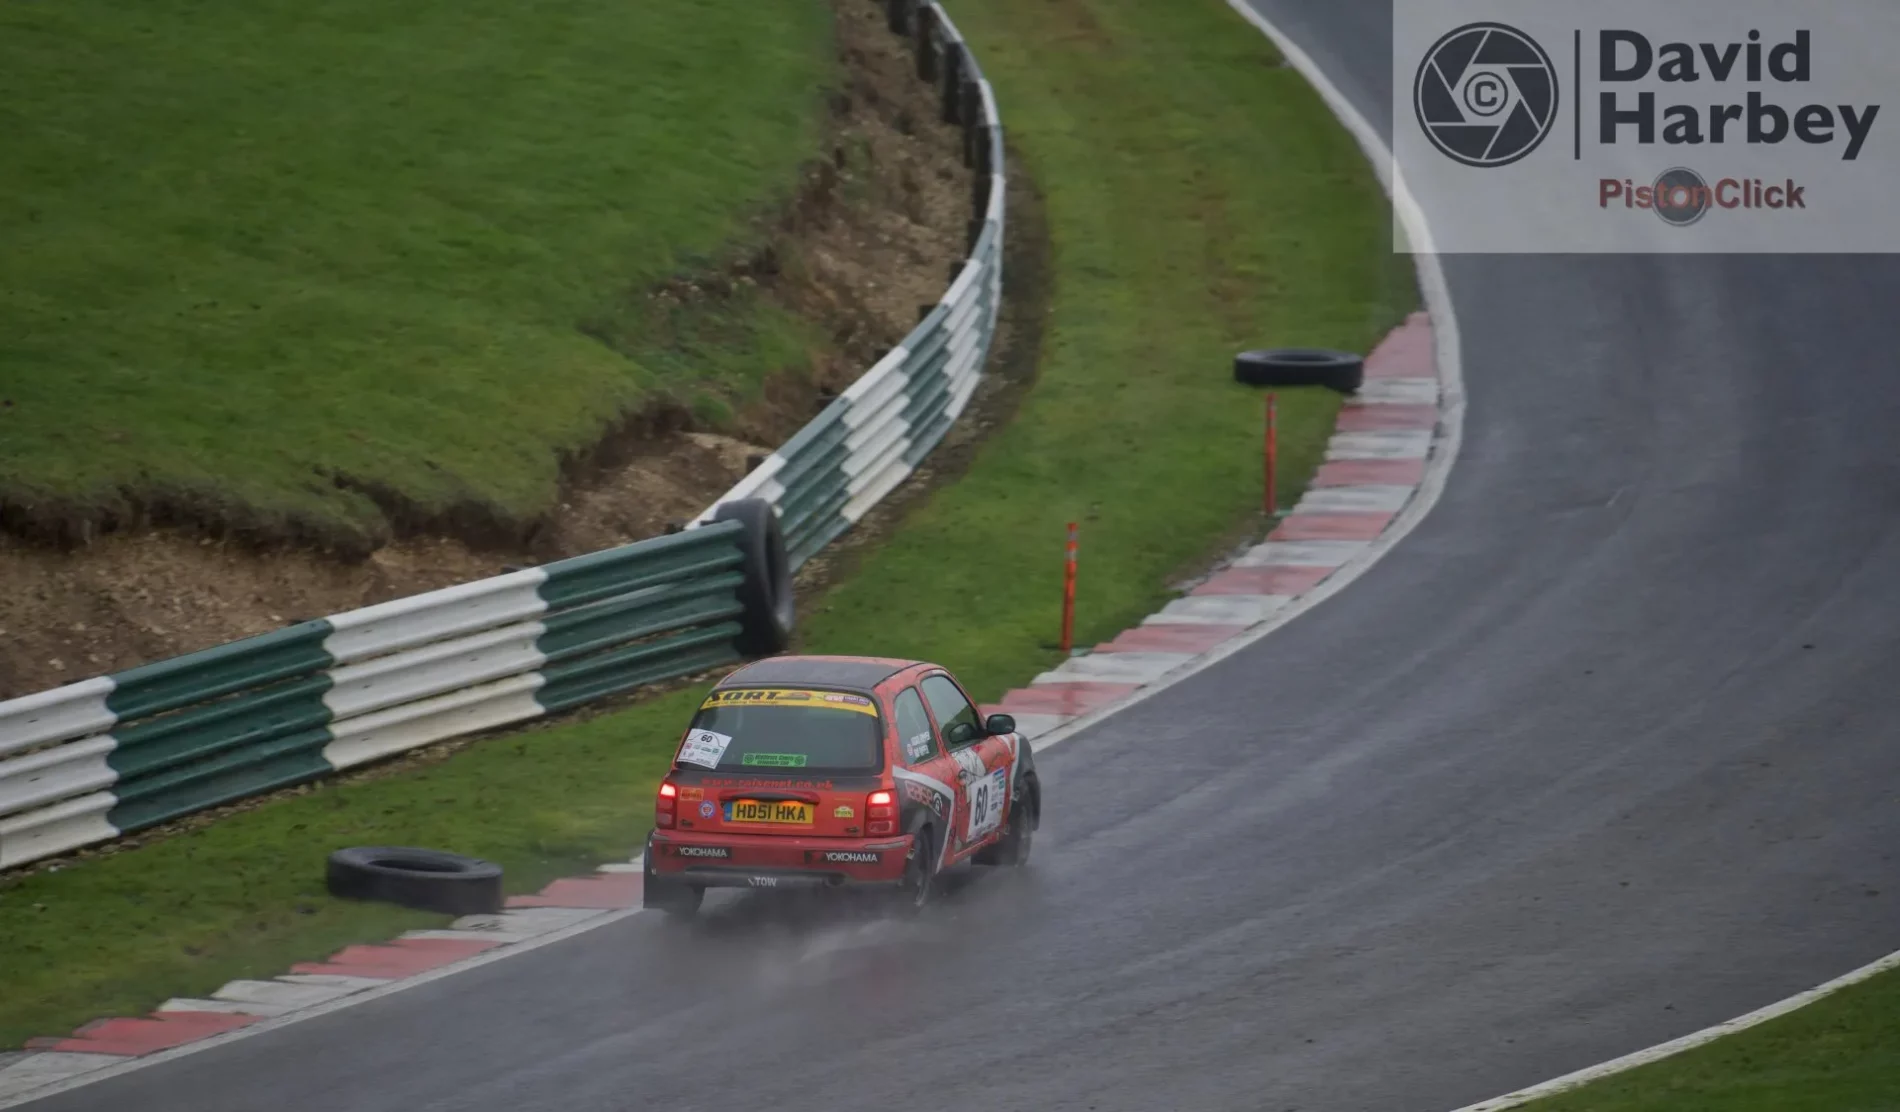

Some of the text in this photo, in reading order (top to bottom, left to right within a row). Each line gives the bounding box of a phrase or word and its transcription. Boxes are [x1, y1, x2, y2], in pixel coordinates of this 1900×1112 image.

[701, 734, 713, 743] 60
[974, 784, 988, 827] 60
[736, 804, 807, 821] HD51 HKA
[679, 846, 728, 858] YOKOHAMA
[826, 852, 878, 862] YOKOHAMA
[754, 876, 777, 887] TOW
